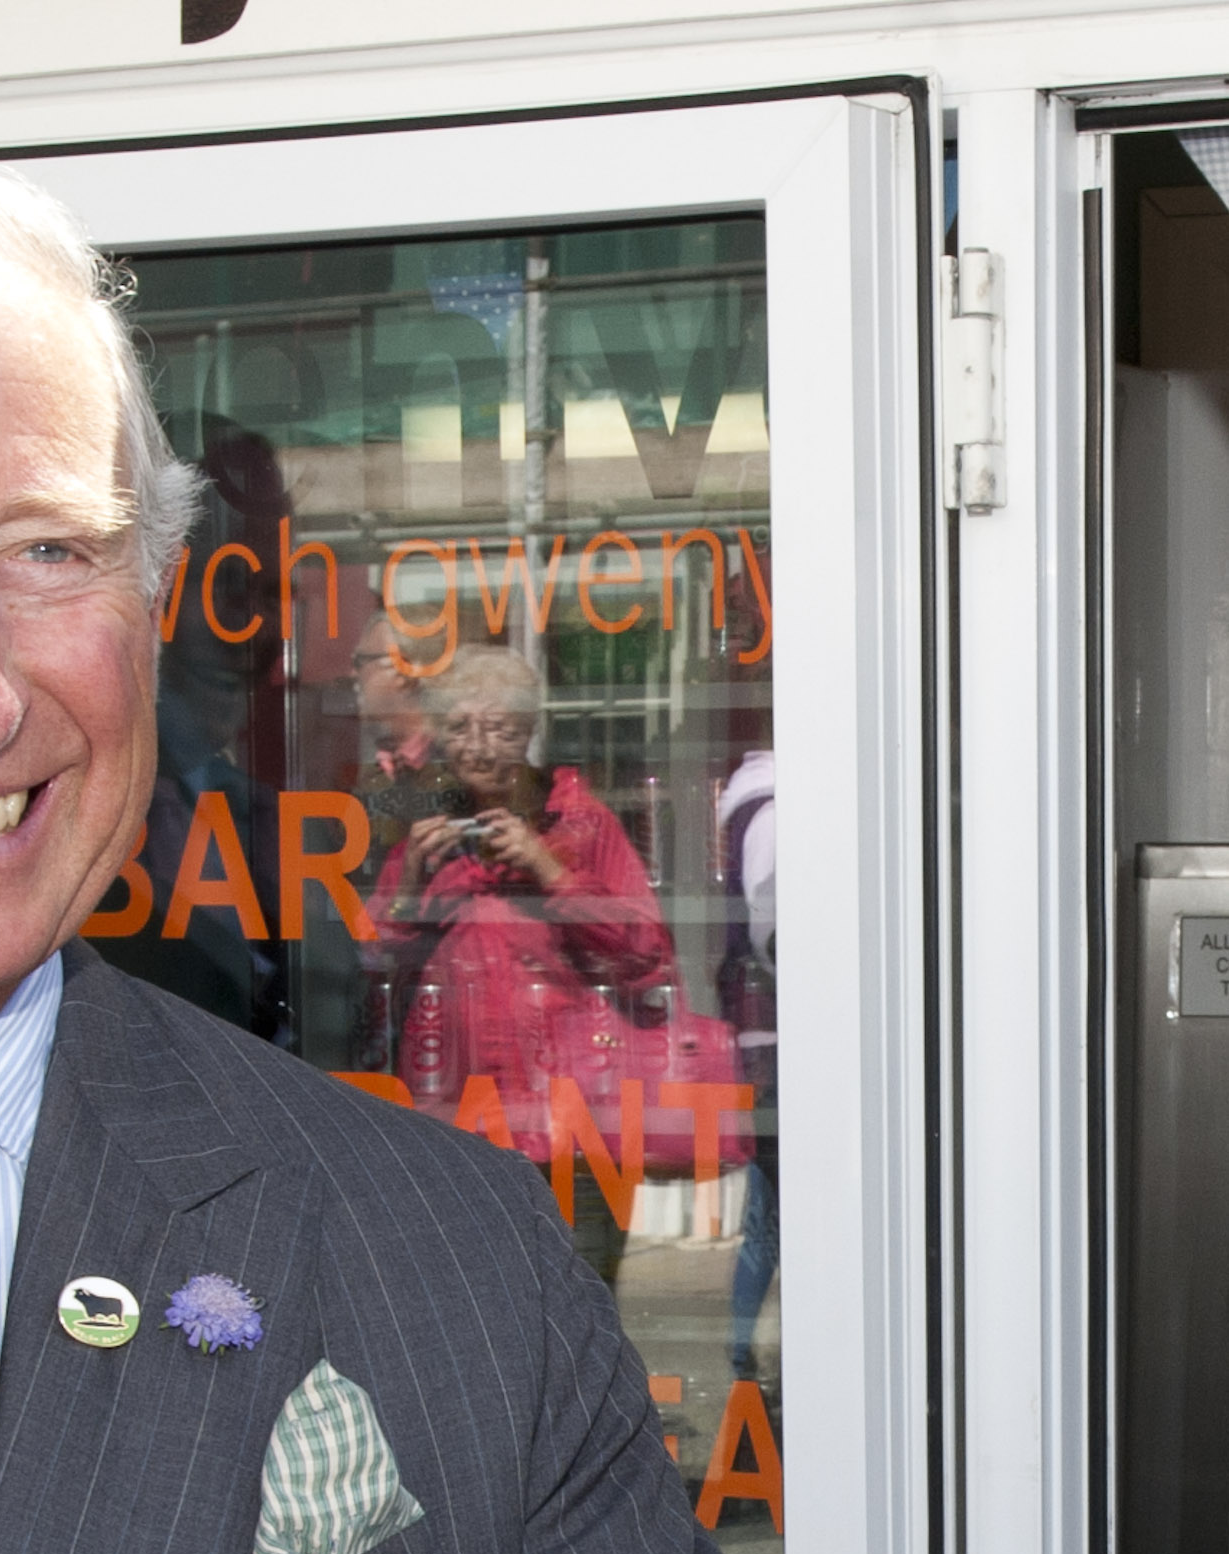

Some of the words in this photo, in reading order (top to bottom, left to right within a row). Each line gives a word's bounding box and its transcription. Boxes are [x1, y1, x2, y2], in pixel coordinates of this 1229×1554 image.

[383, 525, 772, 678] gweny
[408, 994, 445, 1073] Coke
[327, 1072, 755, 1236] NT
[647, 1375, 783, 1535] A
